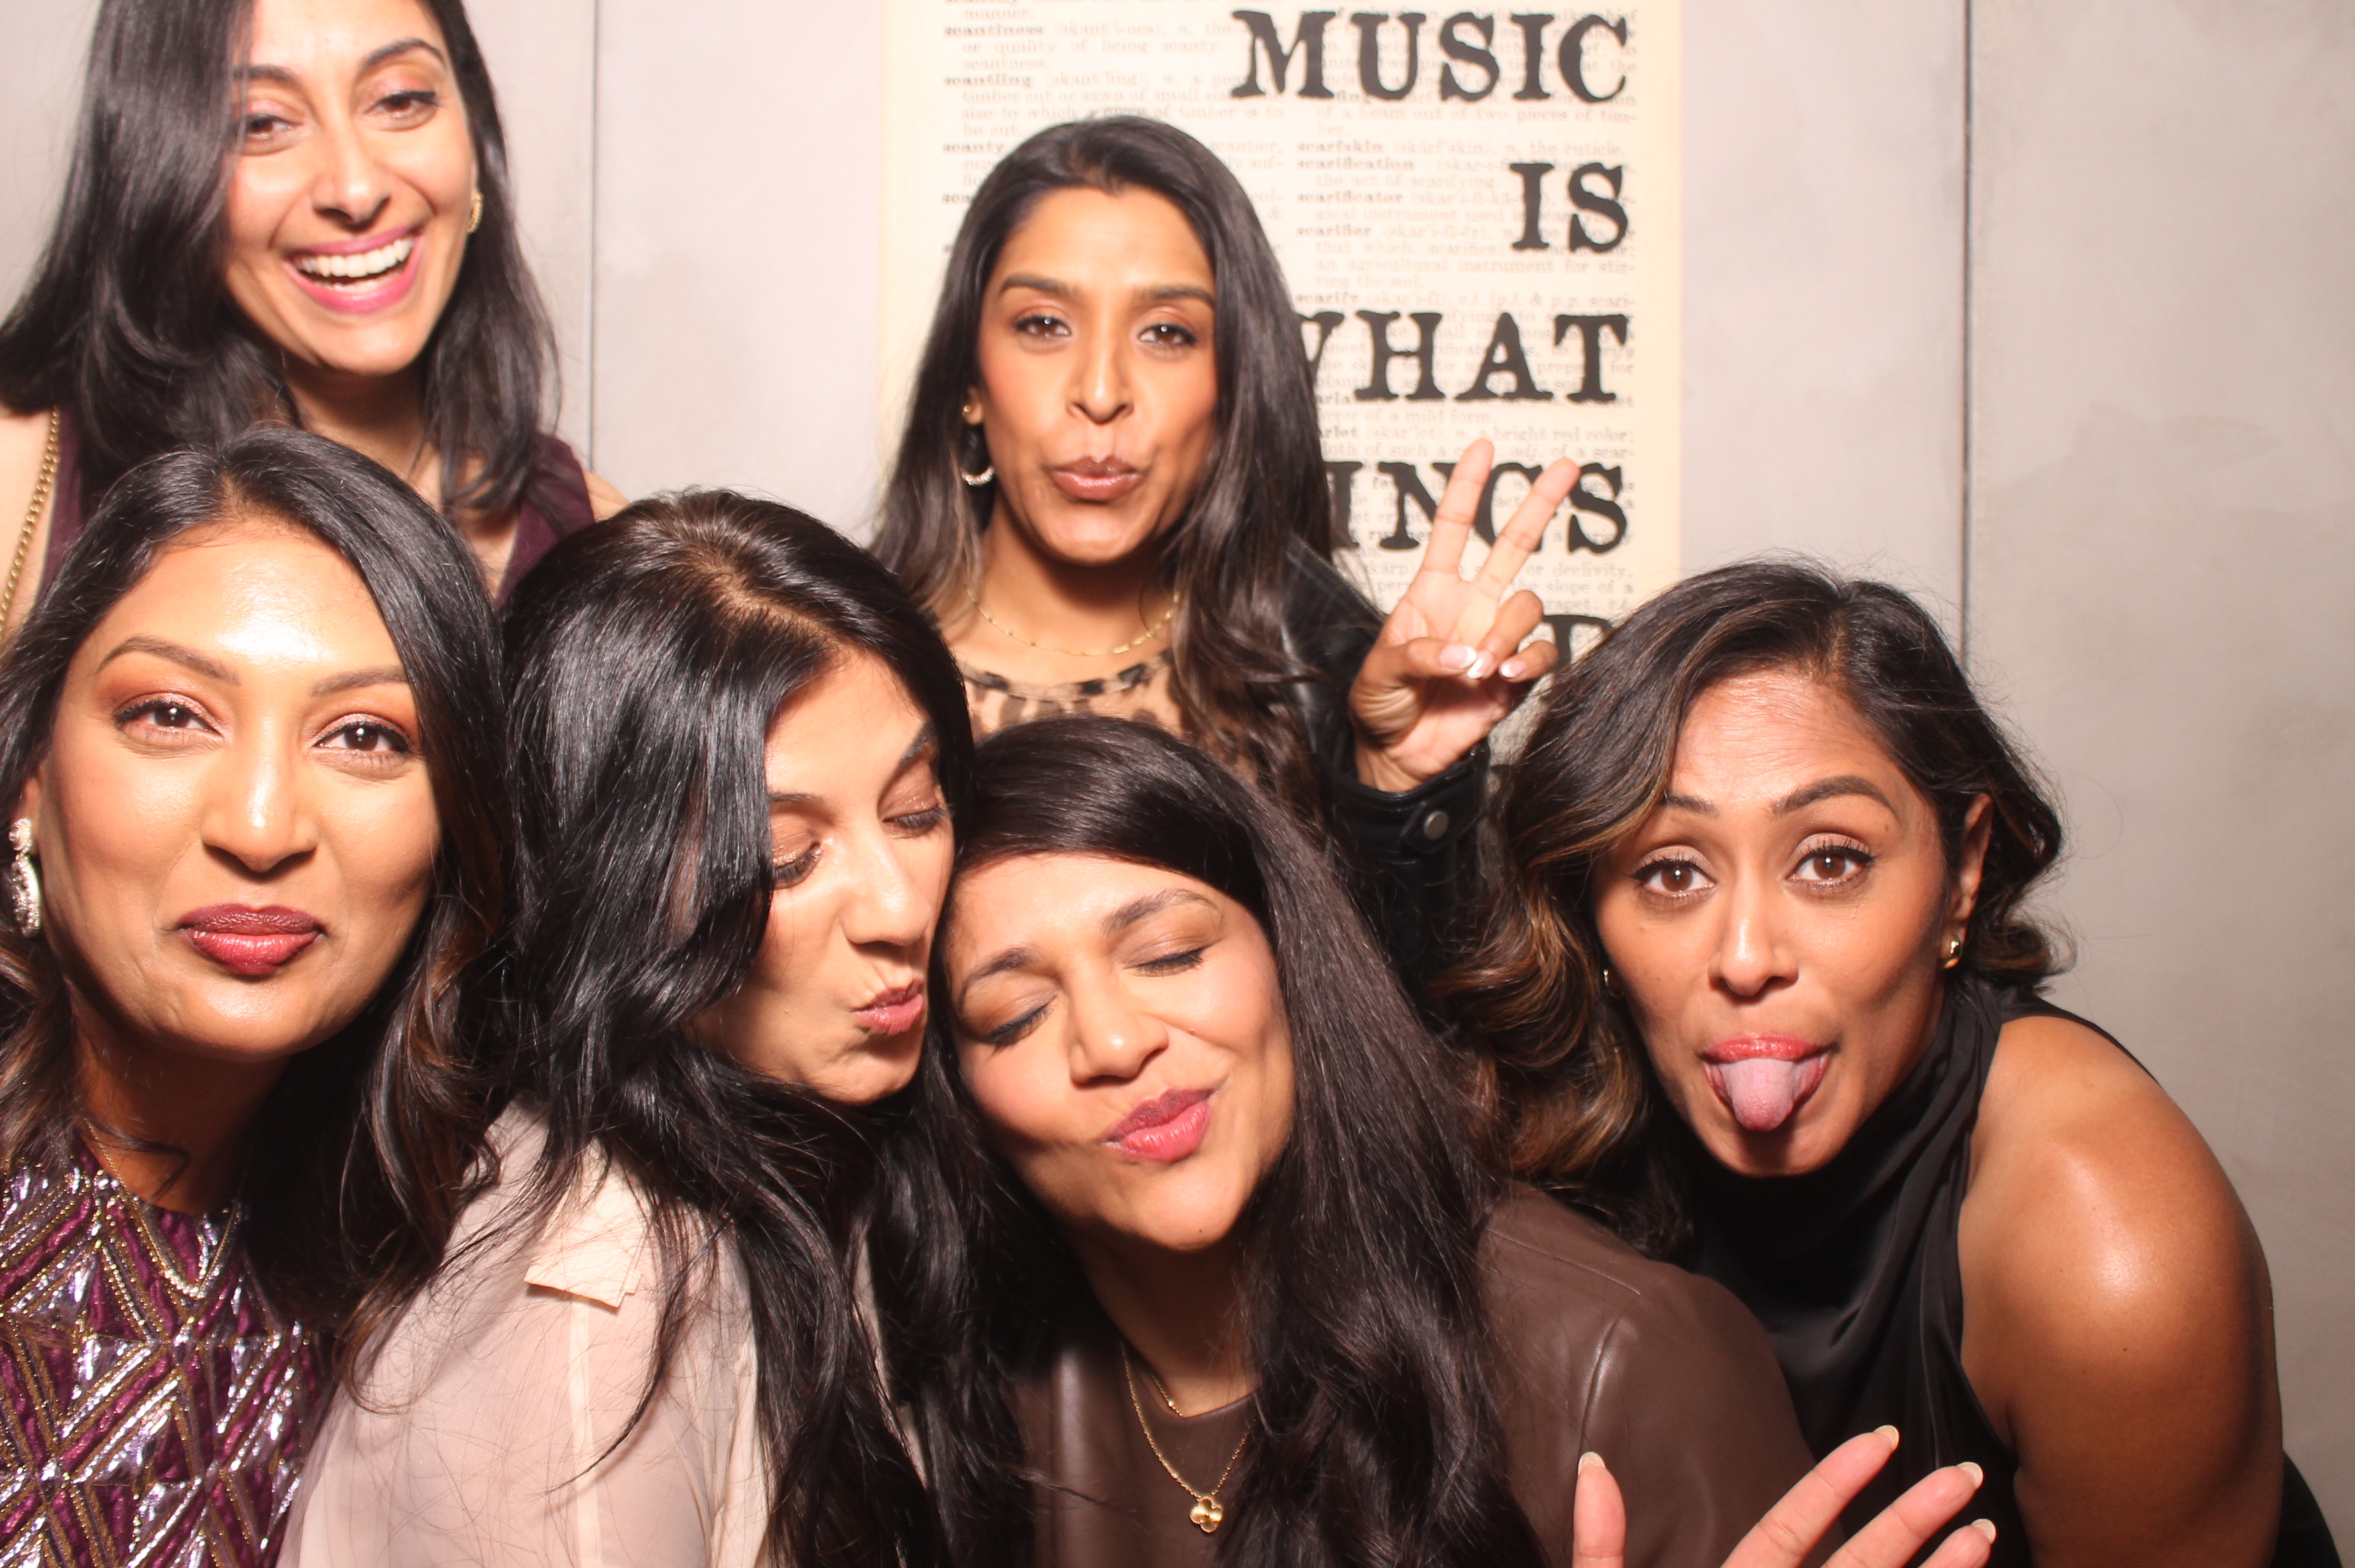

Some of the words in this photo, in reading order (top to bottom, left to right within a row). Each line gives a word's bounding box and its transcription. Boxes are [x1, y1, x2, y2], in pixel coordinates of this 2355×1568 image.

[1229, 10, 1628, 105] MUSIC
[1296, 156, 1415, 172] scarification
[1296, 190, 1404, 204] scarificator
[1508, 162, 1629, 254] IS
[1296, 223, 1372, 238] scarifier
